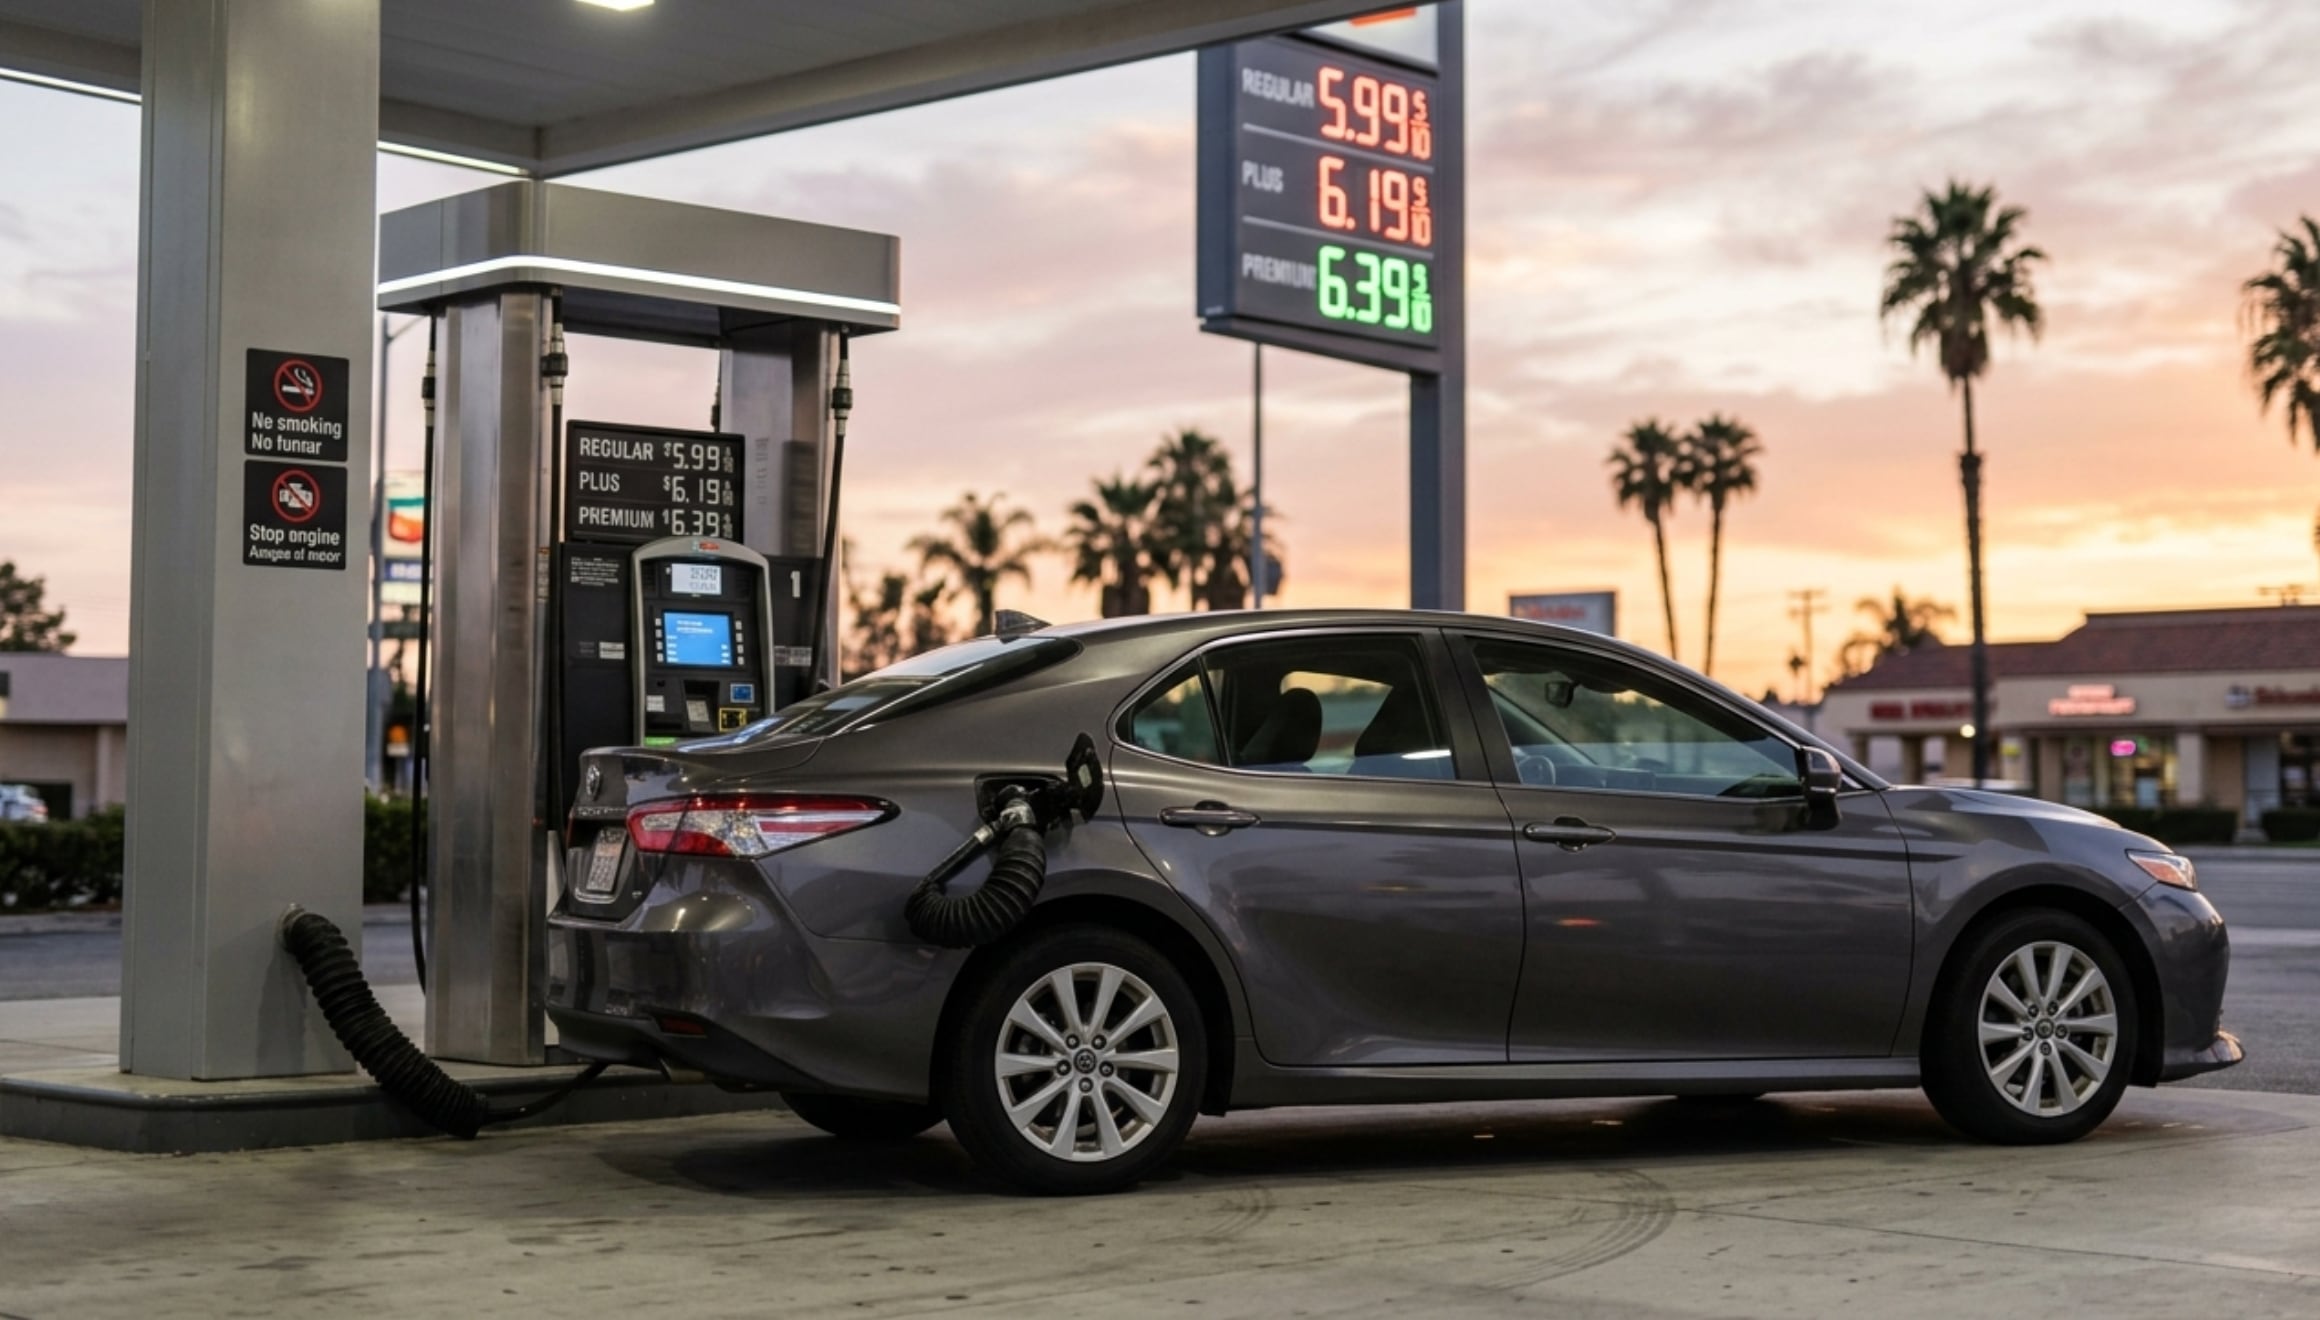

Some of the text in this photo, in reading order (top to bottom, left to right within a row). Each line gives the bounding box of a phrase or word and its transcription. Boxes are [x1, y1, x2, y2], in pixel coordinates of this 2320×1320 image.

[1242, 68, 1314, 108] REGULAR
[1318, 66, 1408, 154] 5.99
[1242, 160, 1284, 193] PLUS
[1318, 156, 1408, 241] 6.19
[1318, 245, 1409, 329] 6.39
[277, 416, 342, 439] smoking
[252, 433, 273, 450] No
[580, 437, 653, 460] REGULAR
[580, 471, 620, 492] PLUS
[579, 506, 654, 528] PREMIUM
[250, 523, 284, 544] Stop
